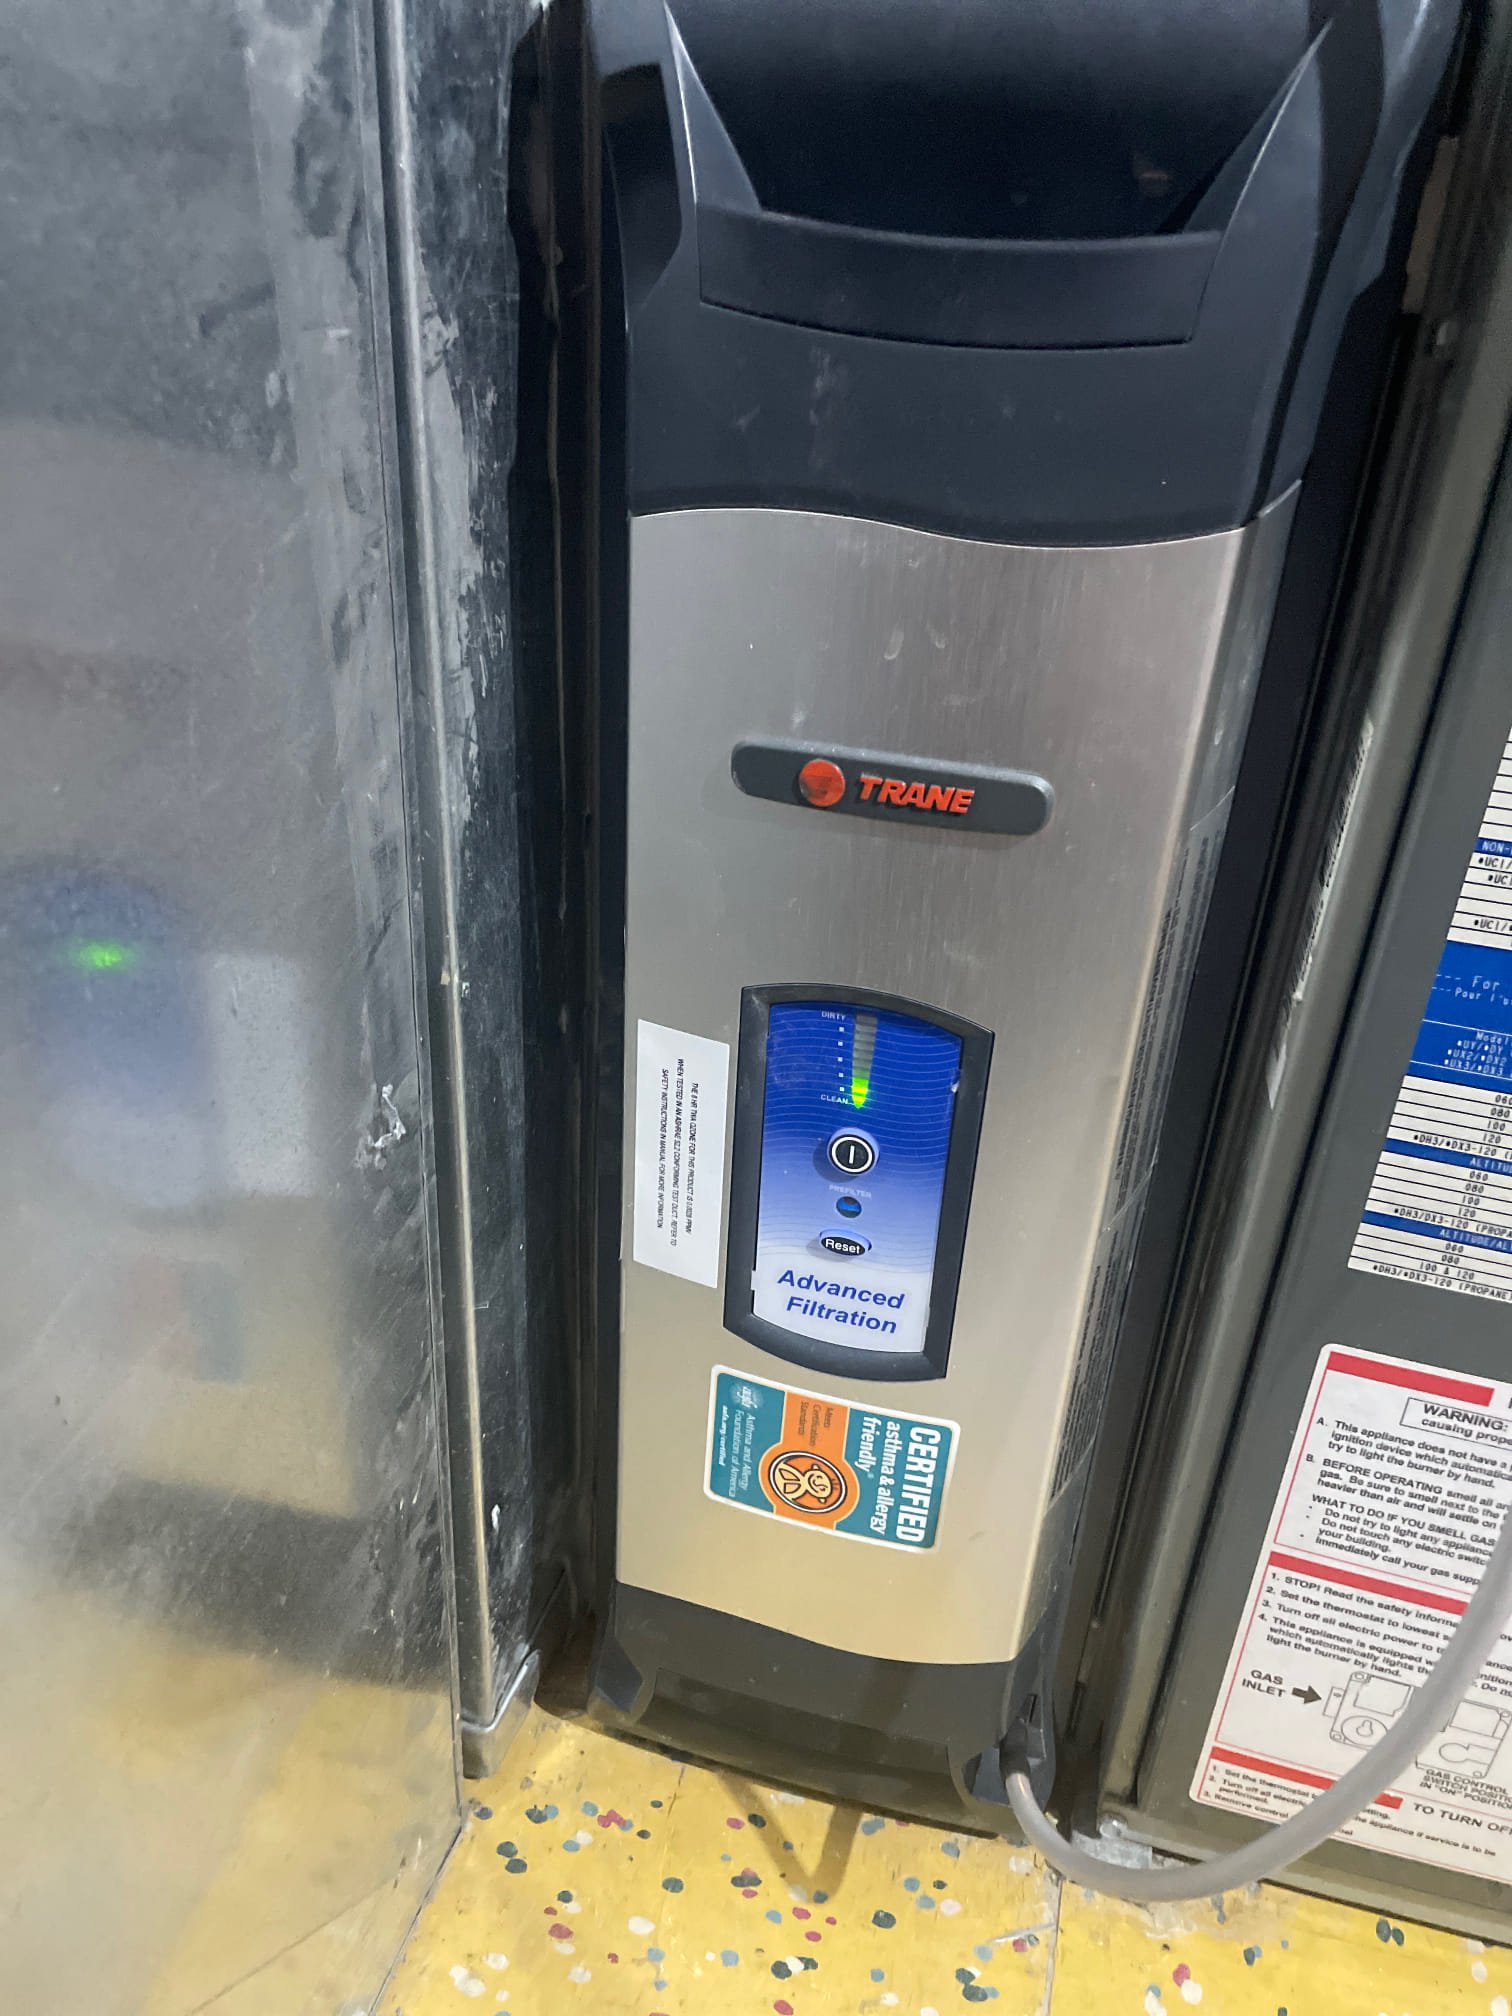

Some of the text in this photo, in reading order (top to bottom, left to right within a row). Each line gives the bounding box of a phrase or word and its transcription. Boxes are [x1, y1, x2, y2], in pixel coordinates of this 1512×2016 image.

[859, 775, 975, 814] TRANE
[1454, 986, 1480, 999] Pour
[1471, 974, 1500, 991] For
[821, 1011, 846, 1021] DIRTY
[676, 1058, 684, 1076] WHEN
[675, 1077, 683, 1100] TESTED
[690, 1082, 698, 1094] THE
[820, 1094, 848, 1105] CLEAN
[659, 1091, 668, 1133] INSTRUCTIONS
[675, 1106, 682, 1116] AN
[1490, 1107, 1510, 1118] 080
[688, 1121, 696, 1142] OZONE
[1482, 1132, 1501, 1144] 120
[1486, 1120, 1506, 1131] 100
[672, 1151, 680, 1188] CONFORMING
[687, 1156, 695, 1168] THIS
[671, 1189, 679, 1202] TEST
[686, 1168, 694, 1195] PRODUCT
[829, 1184, 872, 1199] PREFILTER
[1457, 1207, 1476, 1218] 120
[670, 1238, 677, 1246] TO
[825, 1238, 860, 1254] Reset
[777, 1269, 905, 1309] Advanced
[786, 1296, 897, 1334] Filtration
[808, 1403, 821, 1447] Certification
[1421, 1418, 1473, 1437] causing
[1423, 1403, 1509, 1432] WARNING:
[728, 1409, 744, 1498] Foundation America
[738, 1413, 756, 1491] Asthma and Allergy
[1330, 1430, 1448, 1465] ignition device which
[1335, 1420, 1497, 1466] This appliance does not have
[870, 1421, 902, 1536] asthma & allergy
[1327, 1441, 1496, 1488] try light the burner by hand.
[896, 1426, 941, 1542] CERTIFIED
[1322, 1458, 1493, 1506] BEFORE OPERATING smell all
[1316, 1477, 1496, 1529] heavier than air and will settle on
[1348, 1475, 1364, 1485] Be
[1366, 1481, 1391, 1492] sure
[1407, 1491, 1438, 1503] smell
[1439, 1499, 1465, 1510] next
[1481, 1508, 1499, 1519] the
[1311, 1494, 1346, 1508] WHAT
[1349, 1503, 1364, 1514] TO
[1366, 1508, 1384, 1518] DO
[1401, 1516, 1425, 1529] YOU
[1427, 1523, 1465, 1539] SMELL
[1324, 1508, 1340, 1518] Do
[1341, 1513, 1360, 1523] not
[1362, 1518, 1377, 1529] try
[1392, 1525, 1418, 1538] light
[1419, 1533, 1440, 1544] any
[1317, 1527, 1392, 1553] your building.
[1321, 1517, 1455, 1558] Do not touch any electric
[1315, 1536, 1449, 1577] Immediately call your gas
[1280, 1589, 1439, 1638] Set the thermostat lowest
[1323, 1586, 1412, 1616] Read the safety
[1277, 1603, 1418, 1647] Turn off electric power
[1269, 1626, 1414, 1671] which automatically lights
[1272, 1616, 1422, 1663] This appliance equipped
[1266, 1634, 1402, 1678] light the burner hand.
[1241, 1678, 1285, 1697] INLET
[1250, 1669, 1283, 1685] GAS
[1419, 1781, 1431, 1789] IN
[1423, 1774, 1467, 1791] SWITCH
[1425, 1768, 1507, 1795] GAS CONTROL
[1413, 1802, 1434, 1814] TO
[1440, 1809, 1482, 1827] TURN
